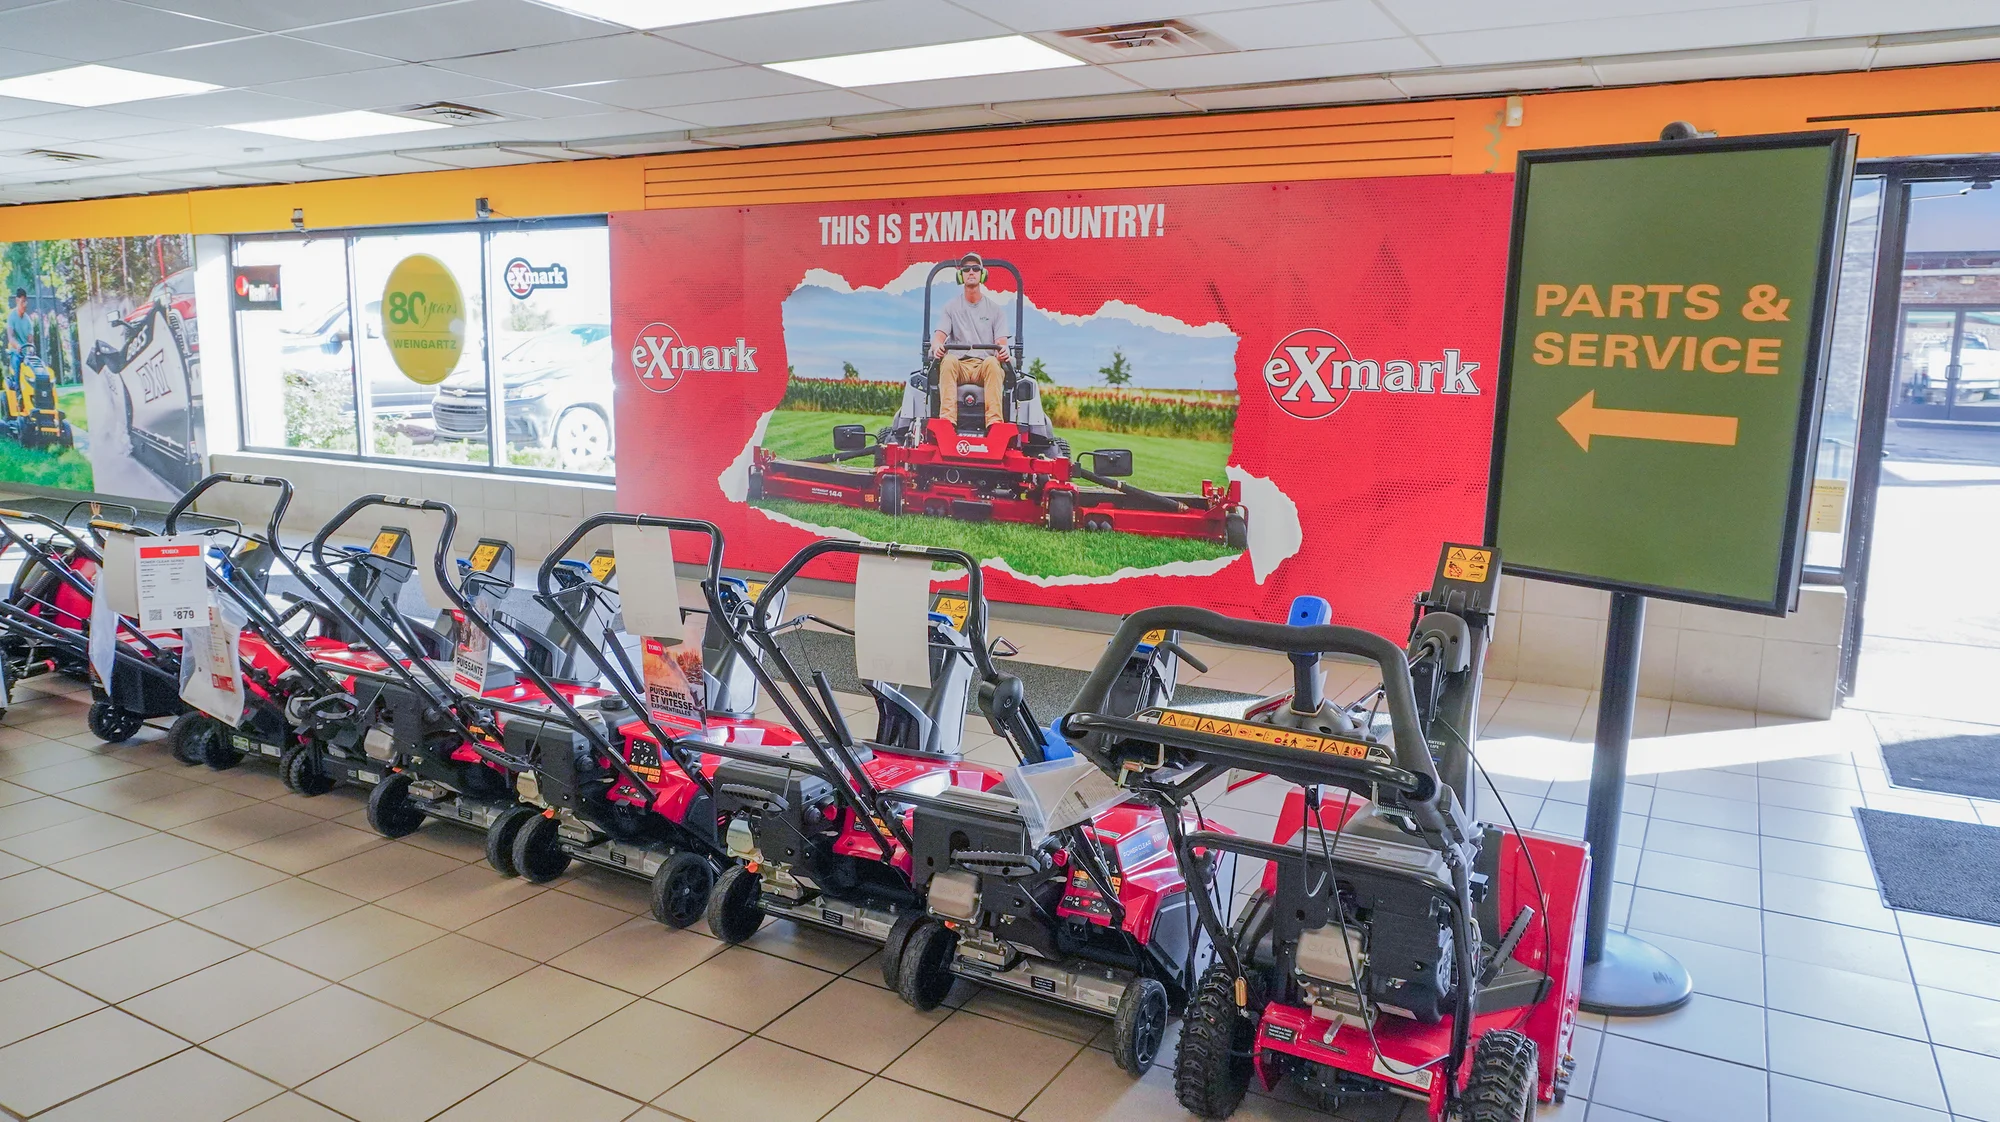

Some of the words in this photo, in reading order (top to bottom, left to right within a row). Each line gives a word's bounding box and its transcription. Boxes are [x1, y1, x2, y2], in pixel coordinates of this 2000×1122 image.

[818, 214, 870, 246] THIS
[877, 213, 902, 244] IS
[909, 208, 1016, 243] EXMARK
[1024, 203, 1165, 240] COUNTRY!
[388, 291, 426, 325] 80
[422, 300, 458, 328] years
[1535, 284, 1721, 321] PARTS
[1741, 284, 1791, 322] &
[393, 339, 457, 350] WEINGARTZ
[1532, 331, 1782, 375] SERVICE
[631, 335, 758, 380] eXmark
[1263, 346, 1480, 403] eXmark
[828, 490, 843, 498] 144
[173, 609, 195, 620] $879
[647, 643, 662, 652] TORO
[456, 656, 484, 677] PUISSANTE
[649, 686, 685, 700] PUISSANCE
[650, 694, 660, 703] ET
[660, 696, 693, 711] VITESSE
[651, 702, 692, 717] EXPONENTIELLES
